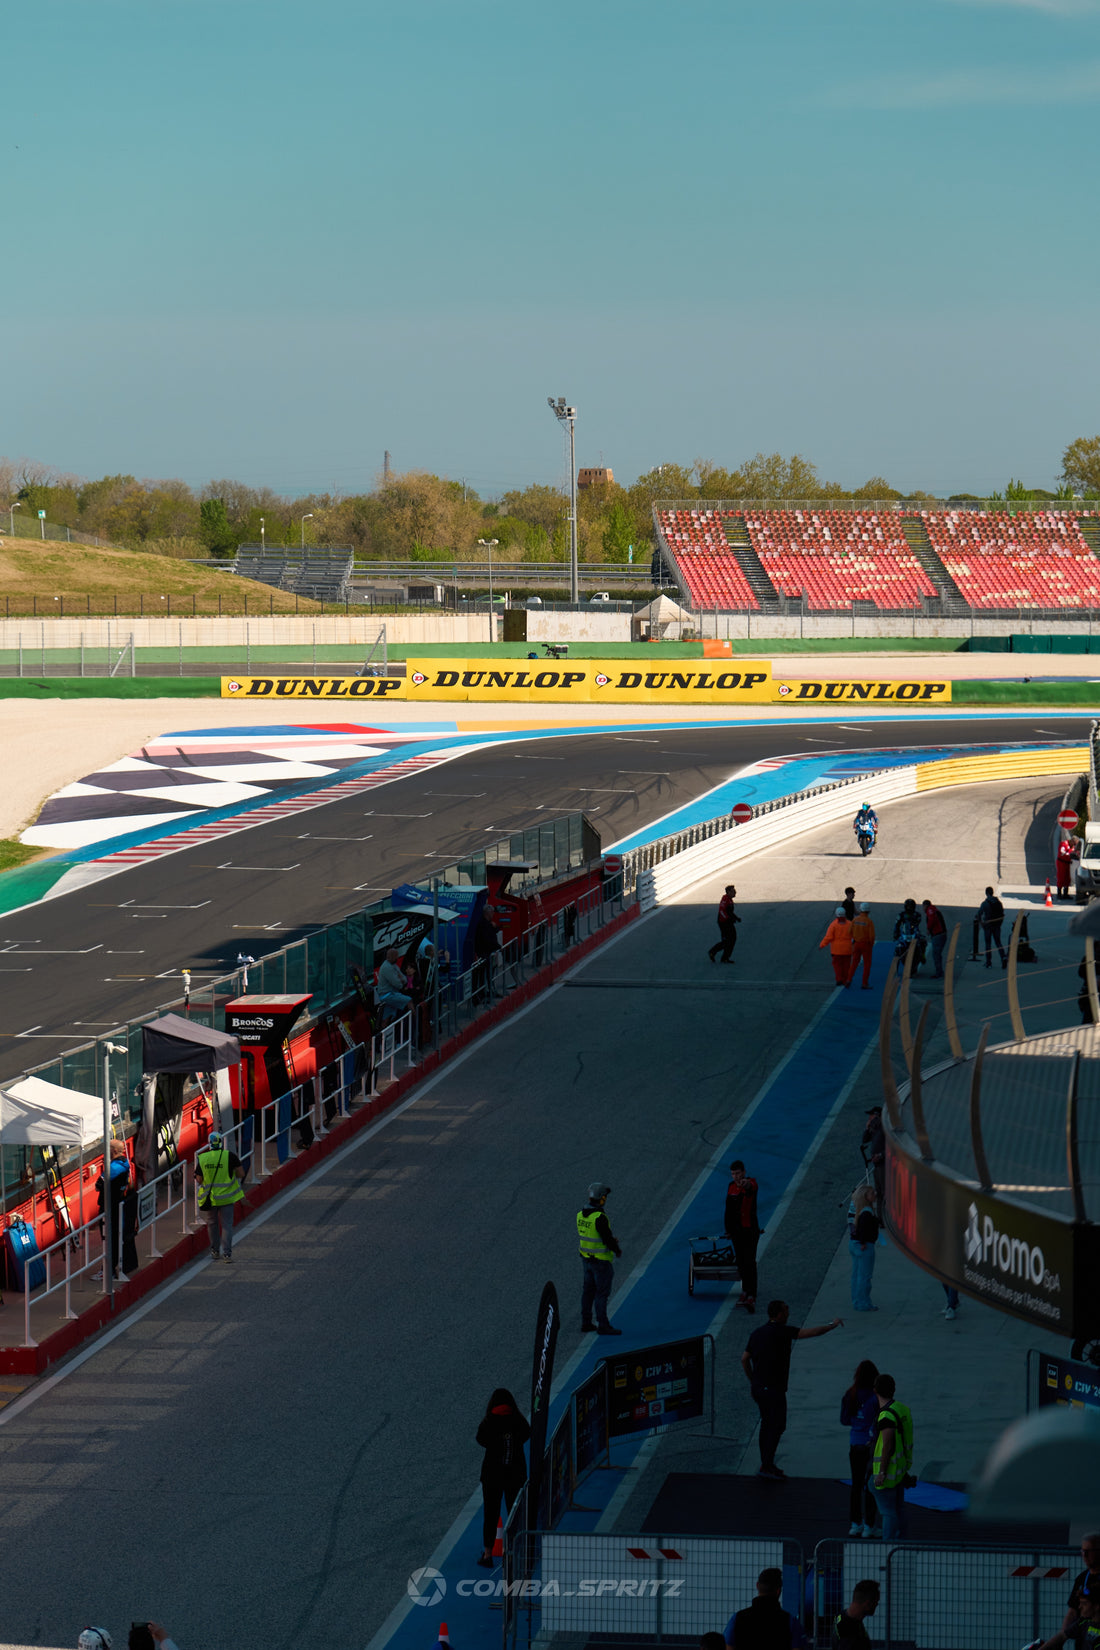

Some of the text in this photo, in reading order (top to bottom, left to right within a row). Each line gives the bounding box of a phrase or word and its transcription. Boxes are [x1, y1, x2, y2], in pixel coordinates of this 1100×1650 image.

[246, 679, 401, 696] DUNLOP
[432, 671, 586, 688] DUNLOP
[615, 673, 767, 689] DUNLOP
[796, 683, 945, 699] DUNLOP
[373, 917, 409, 951] GP
[398, 923, 425, 942] project
[232, 1017, 274, 1028] BRONCOS
[983, 1215, 1045, 1285] Promo
[646, 1364, 662, 1378] CIV
[1074, 1381, 1091, 1394] CIV
